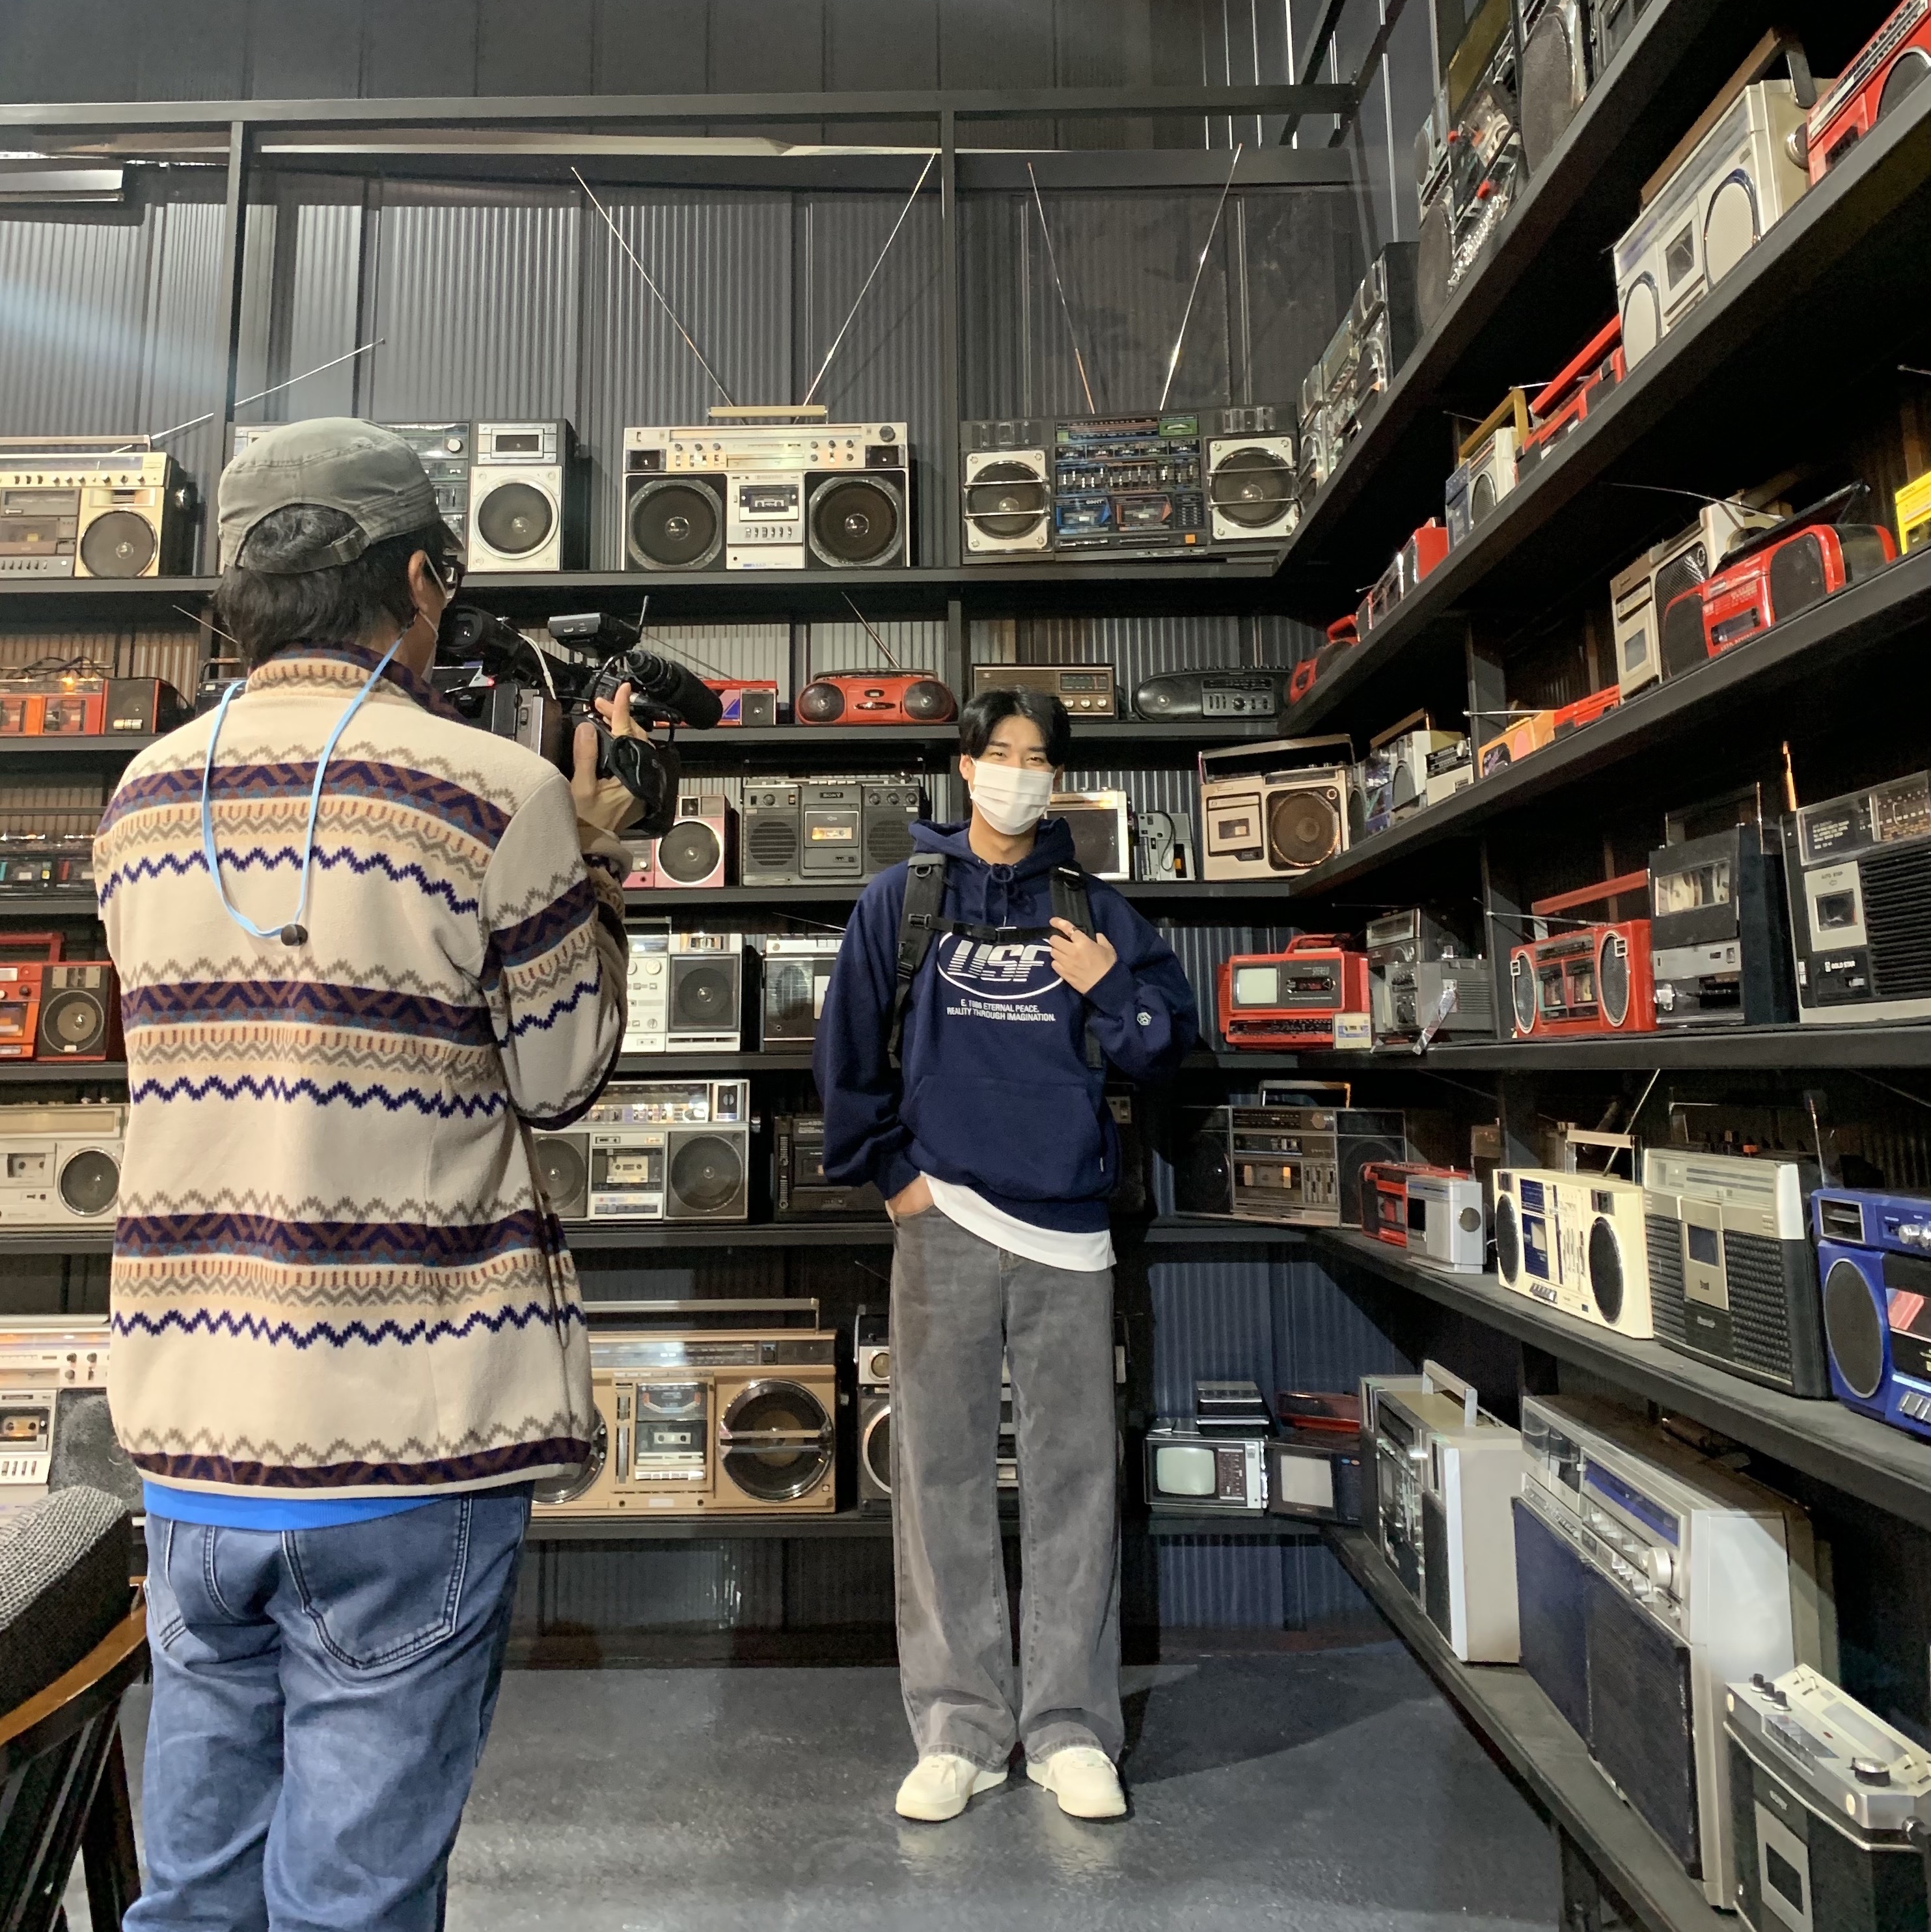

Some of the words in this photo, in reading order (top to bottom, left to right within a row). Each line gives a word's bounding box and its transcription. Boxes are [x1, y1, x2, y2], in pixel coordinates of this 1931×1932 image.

[946, 1006, 972, 1016] REALITY
[972, 1008, 1006, 1021] THROUGH
[983, 1002, 1015, 1013] ETERNAL
